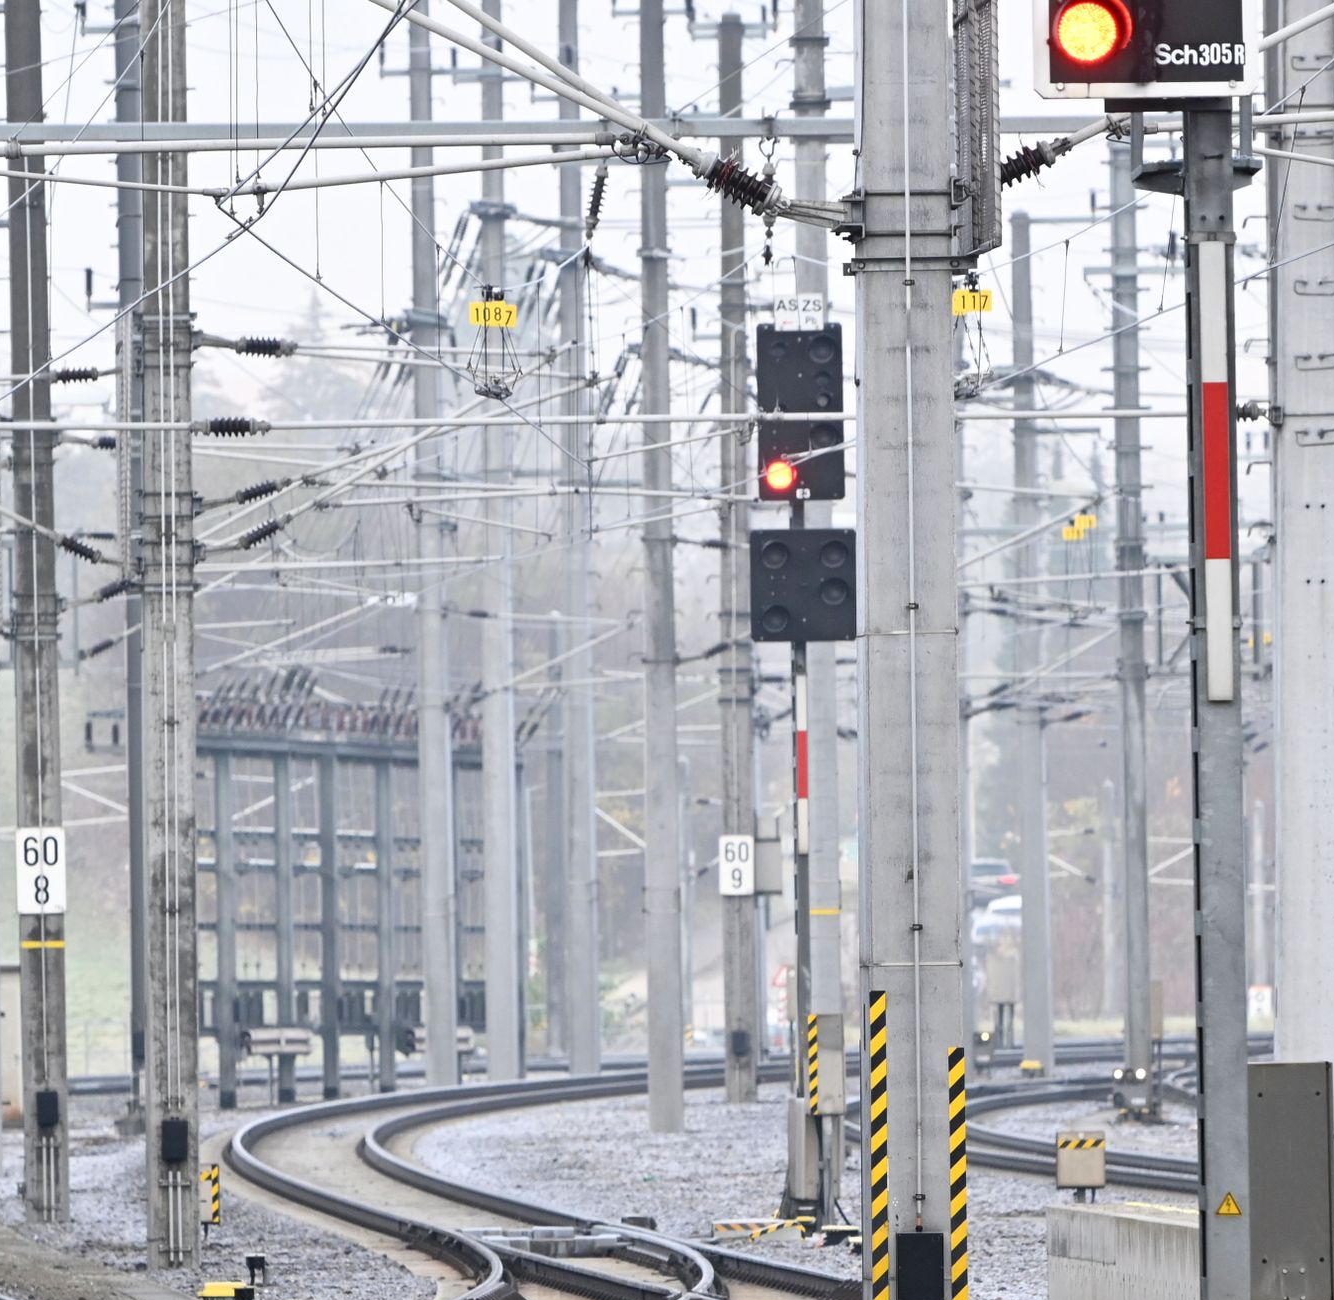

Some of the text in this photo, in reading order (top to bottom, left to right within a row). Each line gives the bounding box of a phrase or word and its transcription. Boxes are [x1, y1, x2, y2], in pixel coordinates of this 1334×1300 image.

[1155, 43, 1245, 65] Sch305R
[475, 307, 513, 325] 1087
[777, 300, 798, 311] AS
[802, 300, 822, 312] ZS
[23, 836, 58, 867] 60
[725, 841, 749, 863] 60
[34, 875, 49, 905] 8
[731, 868, 742, 890] 9
